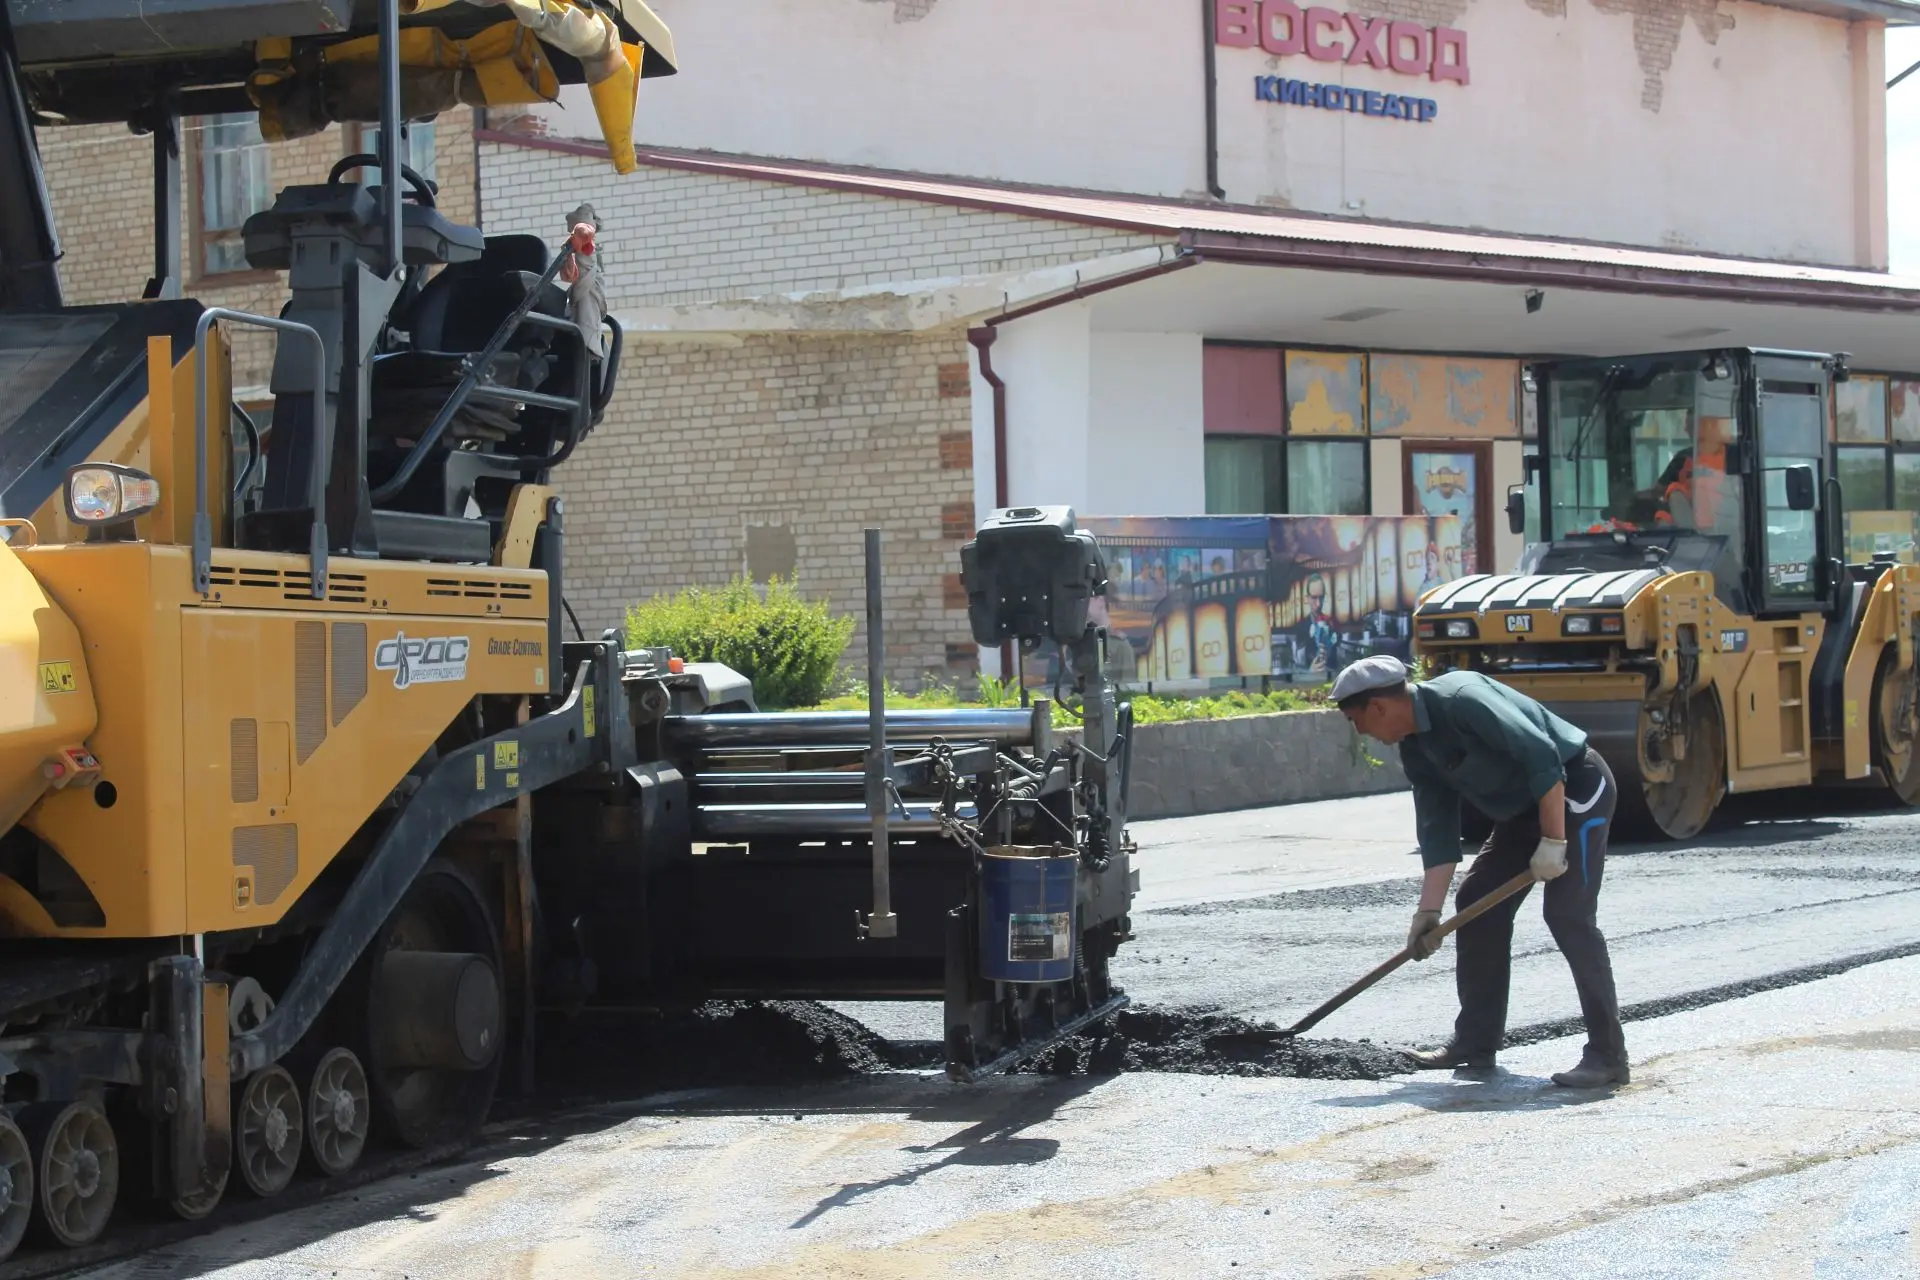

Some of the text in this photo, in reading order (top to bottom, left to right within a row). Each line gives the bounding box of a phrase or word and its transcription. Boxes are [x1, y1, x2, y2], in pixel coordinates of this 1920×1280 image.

[1215, 0, 1470, 85] ВОСХОД
[1255, 75, 1438, 122] КИНОТЕАТР
[1508, 615, 1530, 632] CAT
